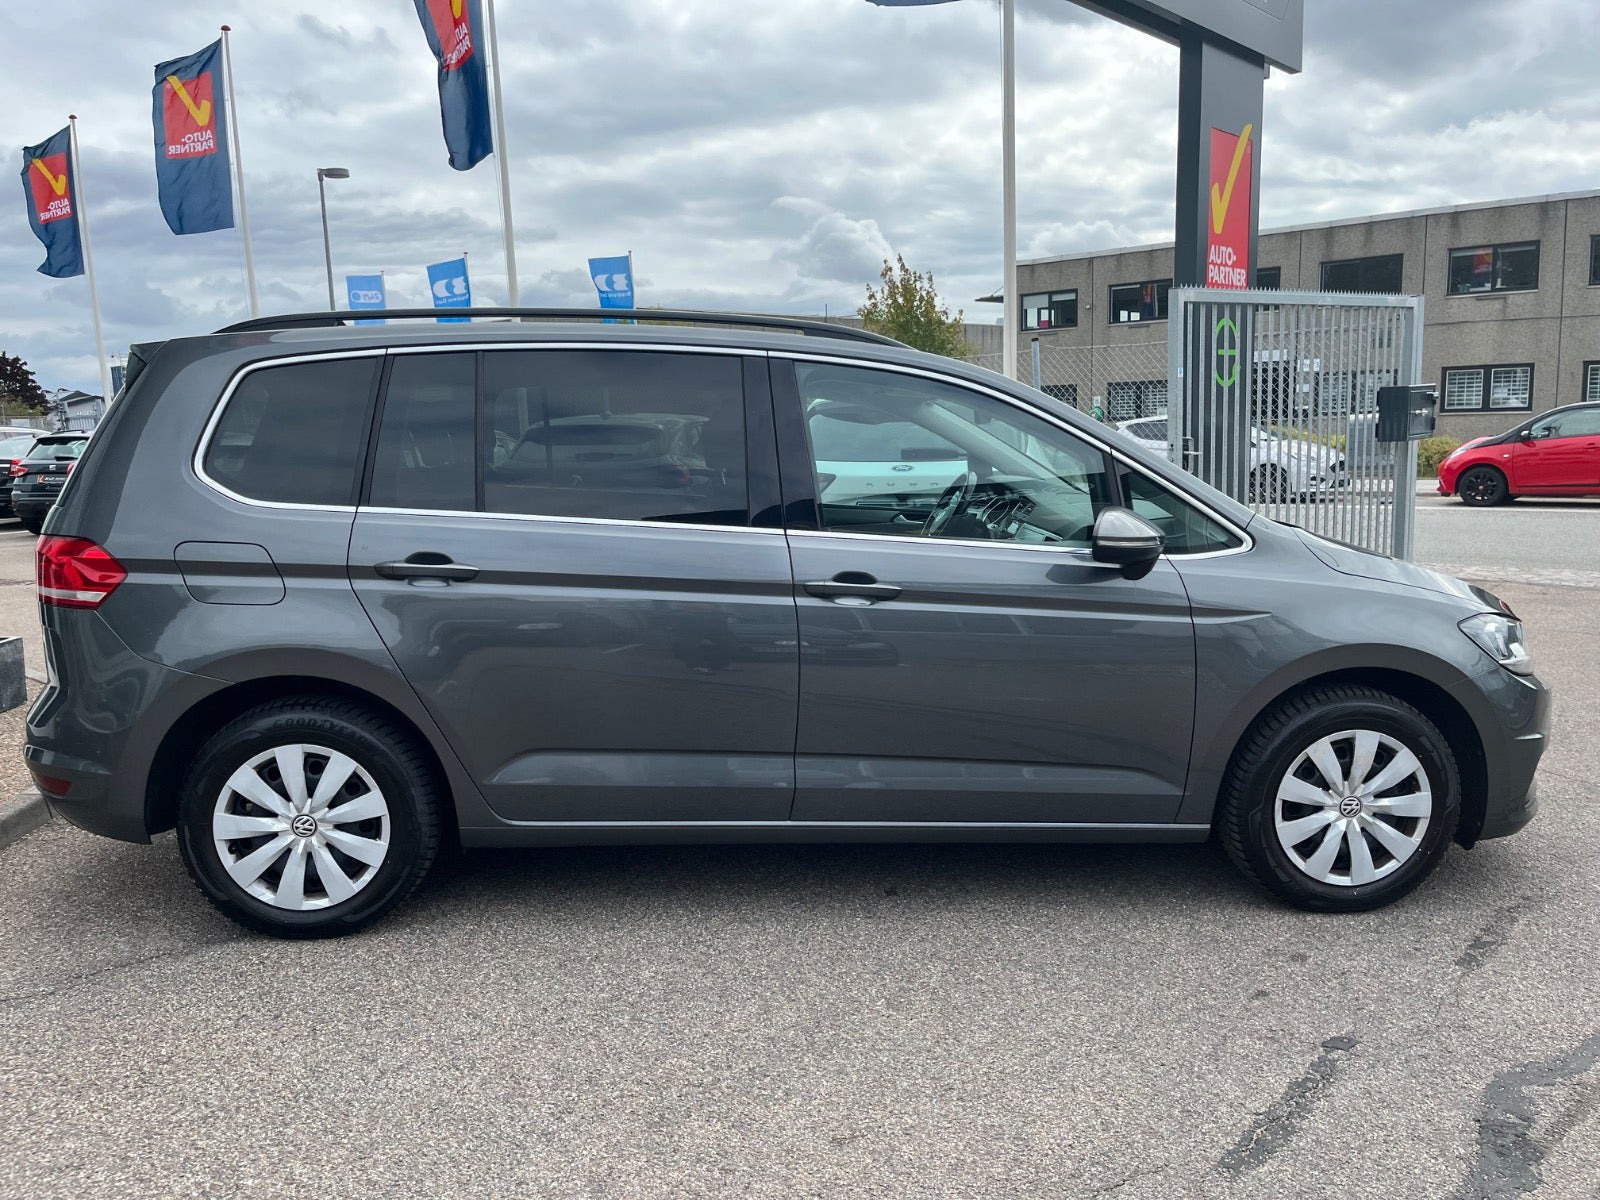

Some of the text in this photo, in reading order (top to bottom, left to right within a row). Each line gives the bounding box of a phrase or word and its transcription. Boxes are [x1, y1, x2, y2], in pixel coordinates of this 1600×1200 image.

[1208, 244, 1237, 266] AUTO-
[1208, 264, 1247, 287] PARTNER
[271, 717, 369, 743] GOODYEAR
